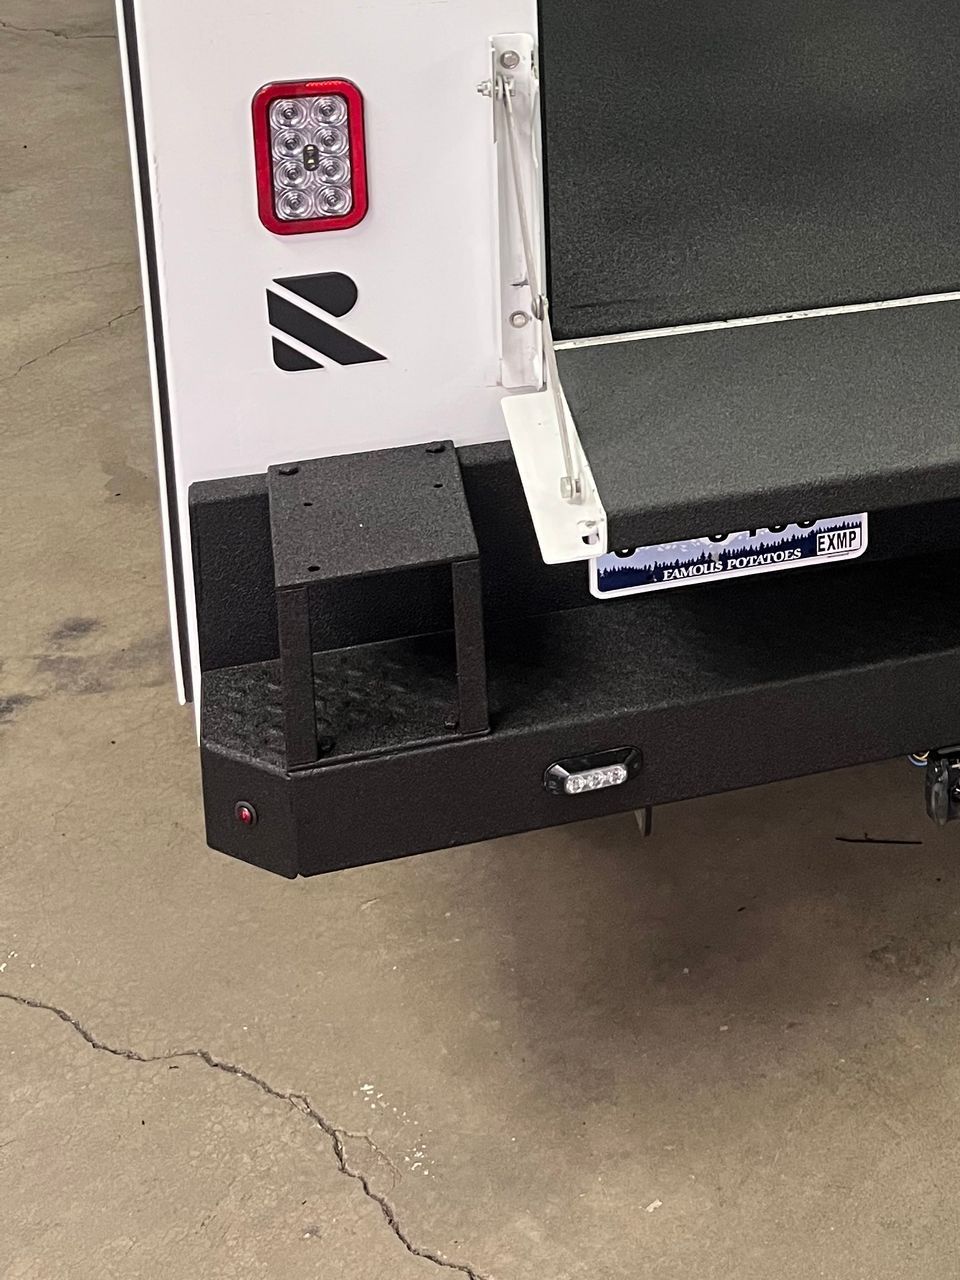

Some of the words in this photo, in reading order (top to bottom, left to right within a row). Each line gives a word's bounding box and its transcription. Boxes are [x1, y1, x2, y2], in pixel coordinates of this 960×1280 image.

[817, 530, 858, 552] EXMP
[663, 561, 724, 581] FAMOUS
[726, 548, 802, 570] POTATOES
